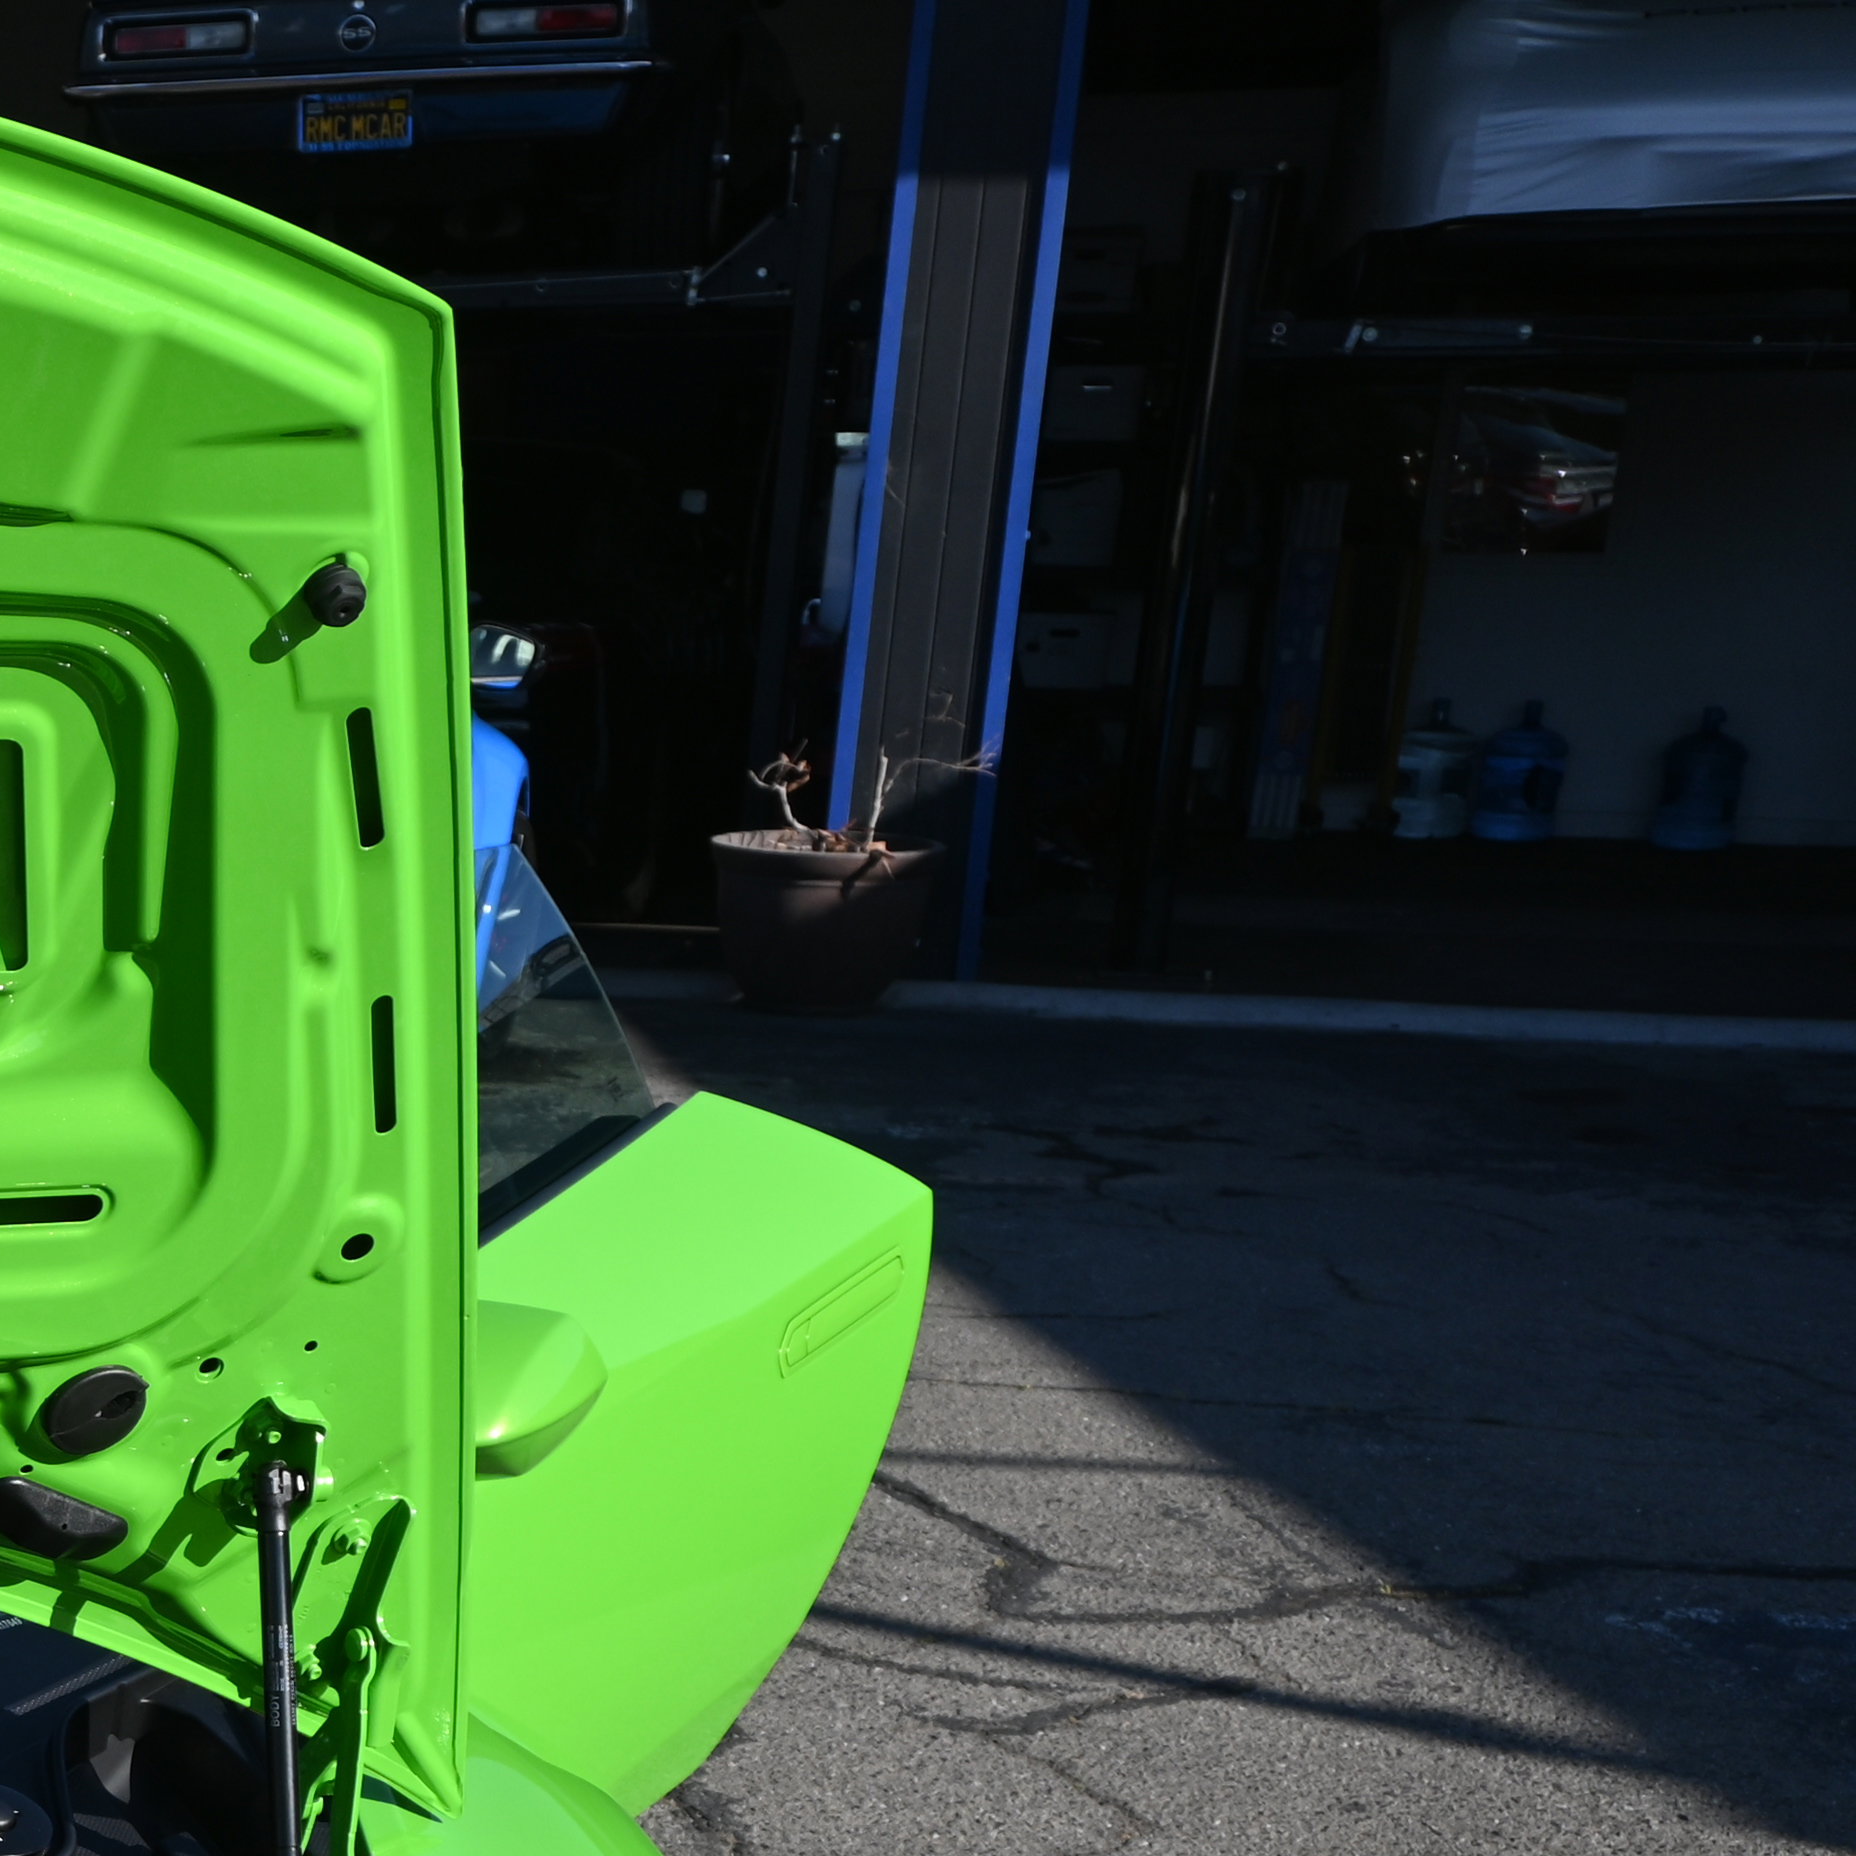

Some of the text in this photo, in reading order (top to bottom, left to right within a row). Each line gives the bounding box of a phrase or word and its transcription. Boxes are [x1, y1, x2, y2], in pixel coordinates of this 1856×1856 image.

[305, 112, 406, 142] RMC MCAR
[271, 1695, 280, 1727] BODY
